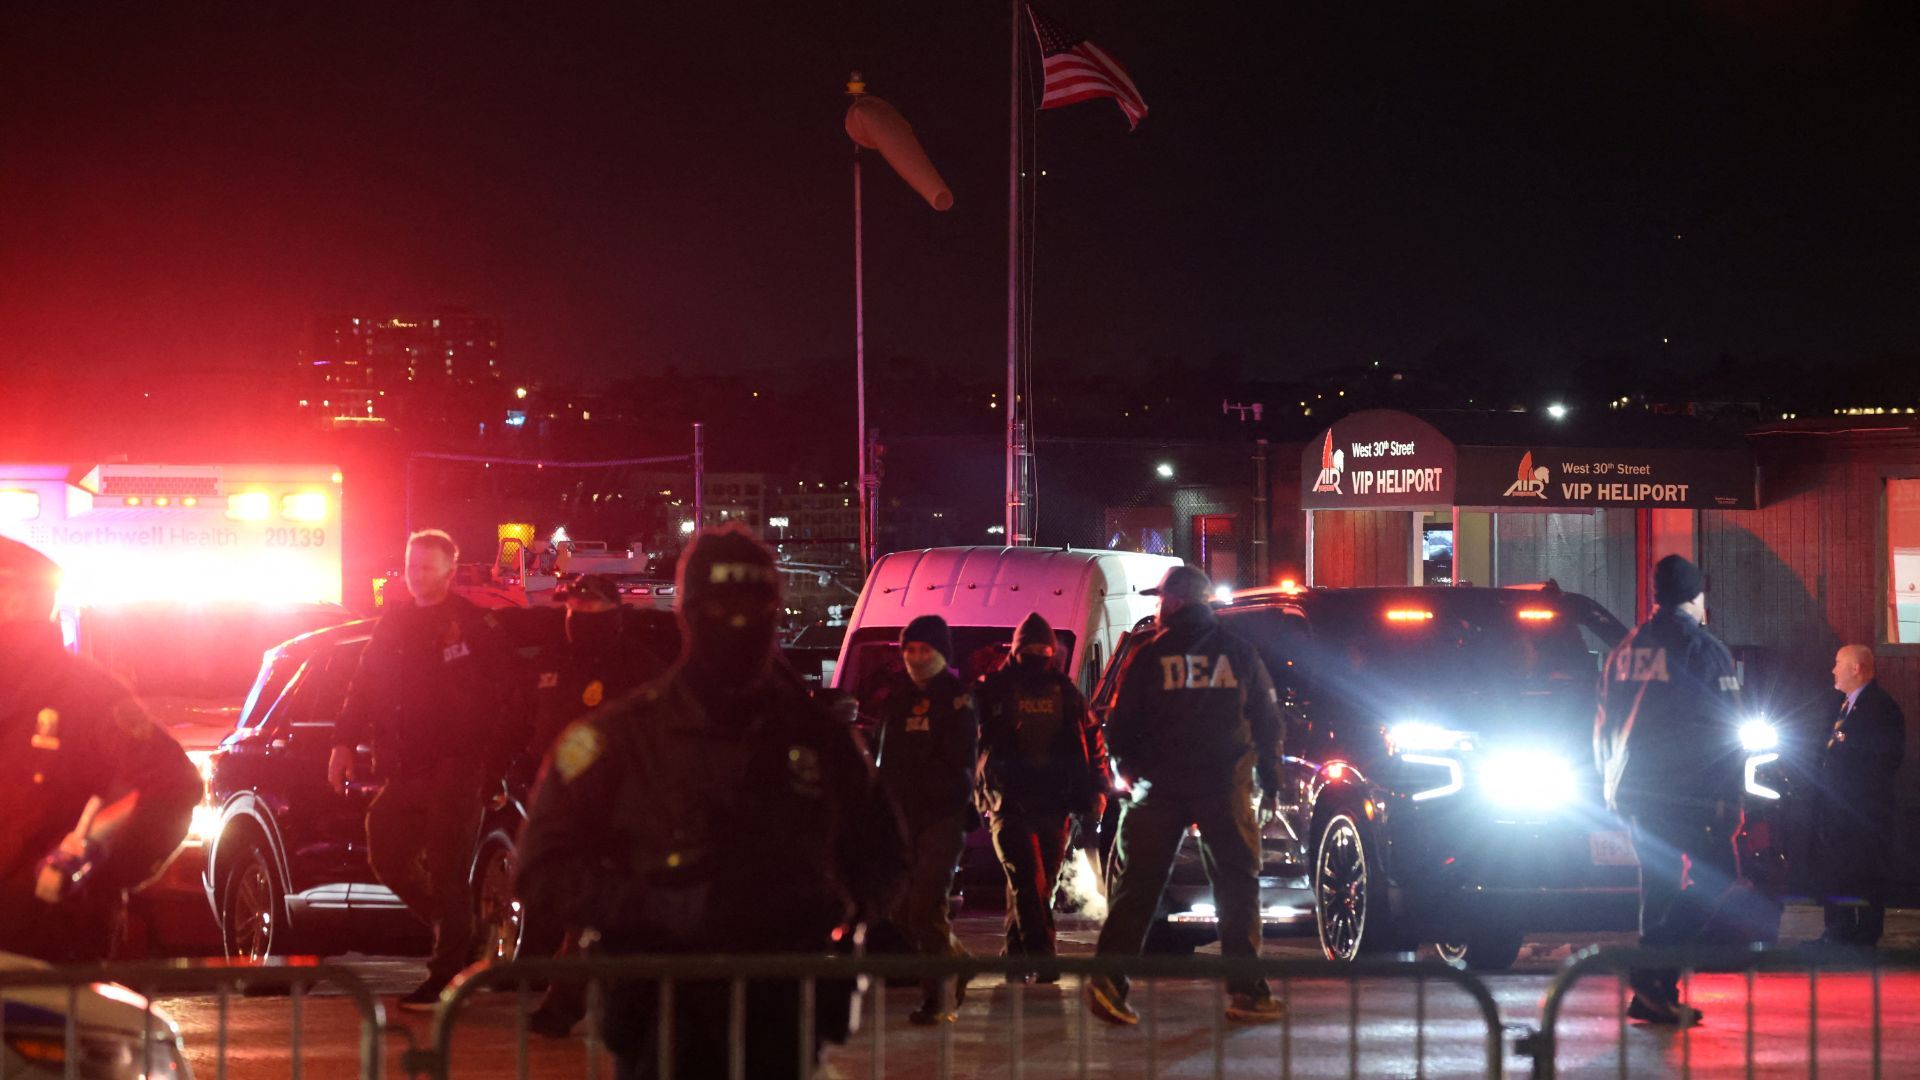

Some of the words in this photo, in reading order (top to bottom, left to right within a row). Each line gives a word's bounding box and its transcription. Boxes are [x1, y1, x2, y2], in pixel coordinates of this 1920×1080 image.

[1352, 442, 1372, 458] West
[1373, 440, 1389, 457] 30th
[1390, 441, 1415, 456] Street
[1561, 462, 1590, 475] West
[1593, 463, 1614, 475] 30th
[1617, 463, 1651, 475] Street
[1312, 469, 1343, 495] AIR
[1351, 471, 1373, 495] VIP
[1376, 468, 1443, 494] HELIPORT
[1503, 480, 1548, 499] AIR
[1561, 483, 1592, 500] VIP
[1598, 484, 1689, 501] HELIPORT
[52, 526, 164, 546] Northwell
[170, 526, 238, 546] Health
[265, 527, 326, 548] 20139
[1160, 654, 1238, 690] DEA
[1018, 699, 1055, 714] POLICE
